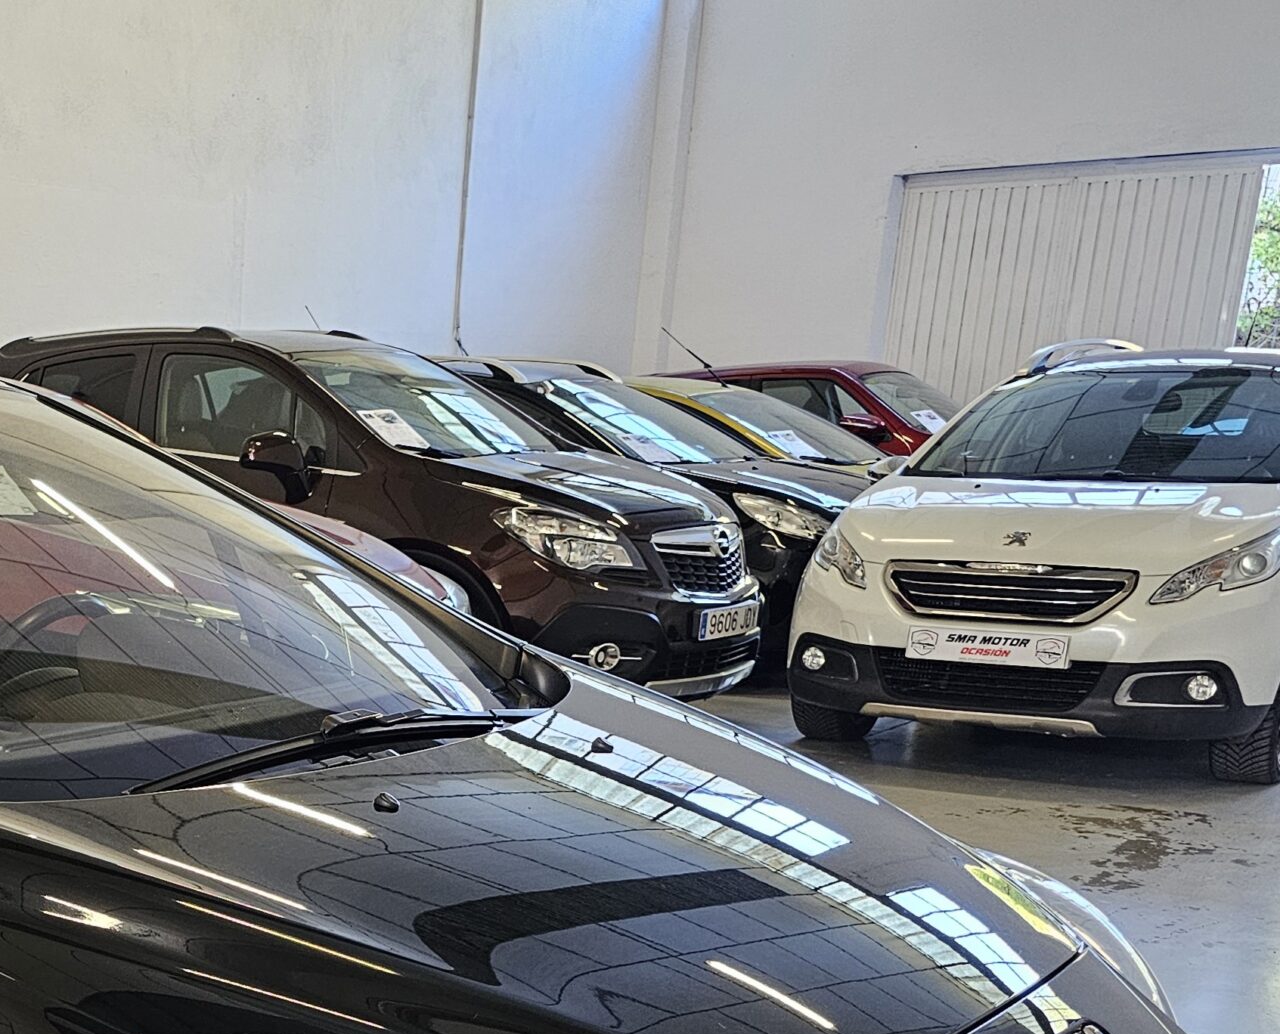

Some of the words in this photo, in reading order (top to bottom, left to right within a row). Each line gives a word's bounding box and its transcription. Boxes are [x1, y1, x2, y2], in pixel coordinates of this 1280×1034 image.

[709, 611, 738, 635] 9606
[945, 633, 977, 644] SMA
[979, 636, 1031, 648] MOTOR
